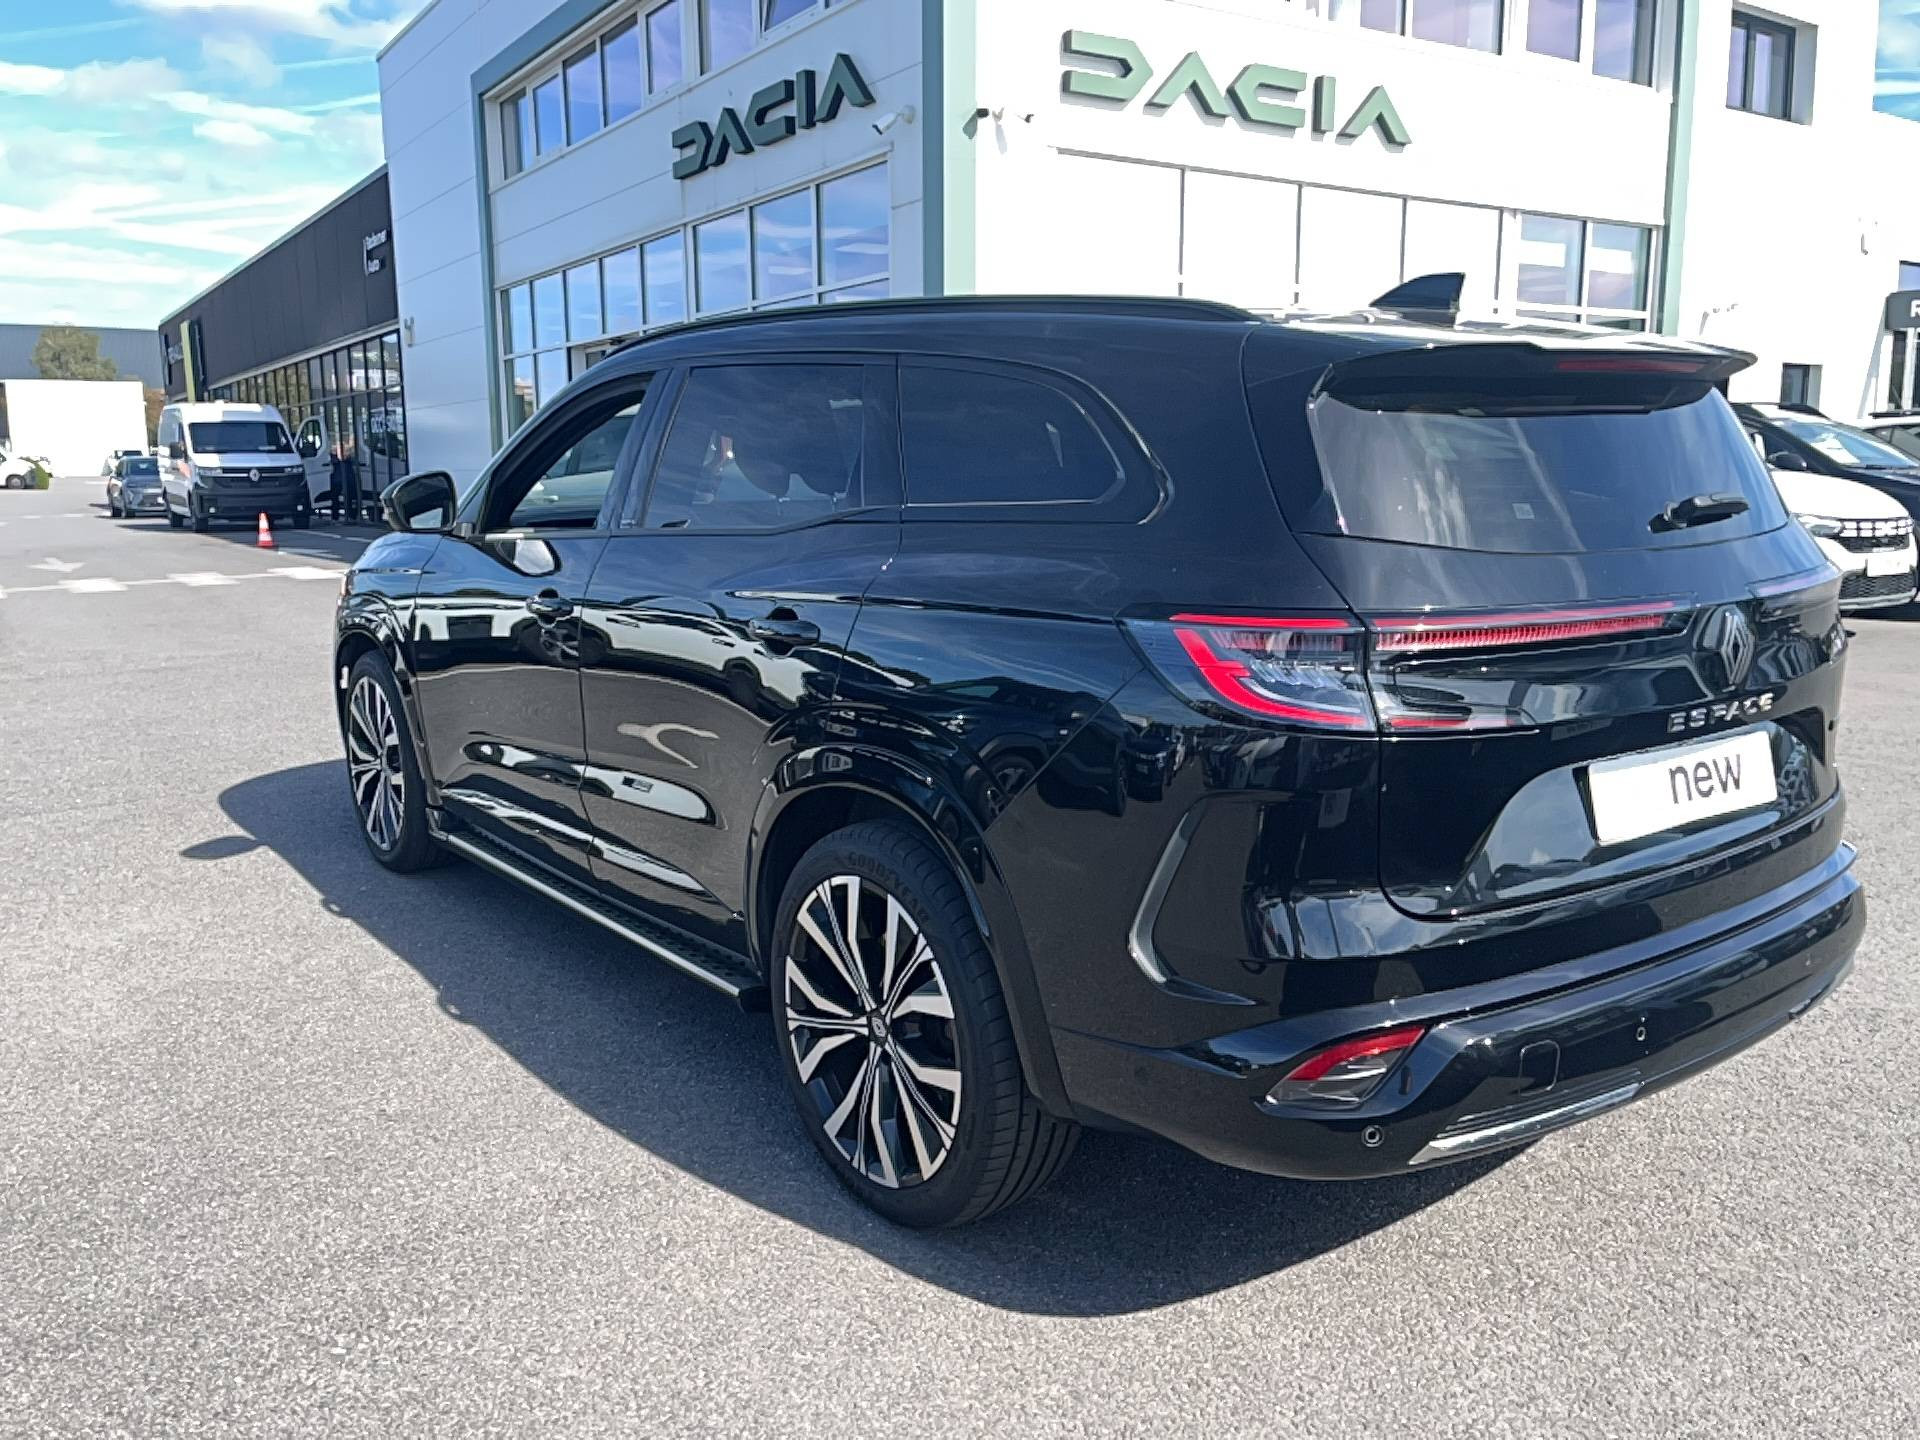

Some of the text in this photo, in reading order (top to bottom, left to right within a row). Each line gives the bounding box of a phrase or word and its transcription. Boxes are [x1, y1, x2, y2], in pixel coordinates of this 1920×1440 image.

[672, 53, 876, 180] DACIA
[1060, 30, 1411, 153] DACIA
[1668, 754, 1741, 804] new
